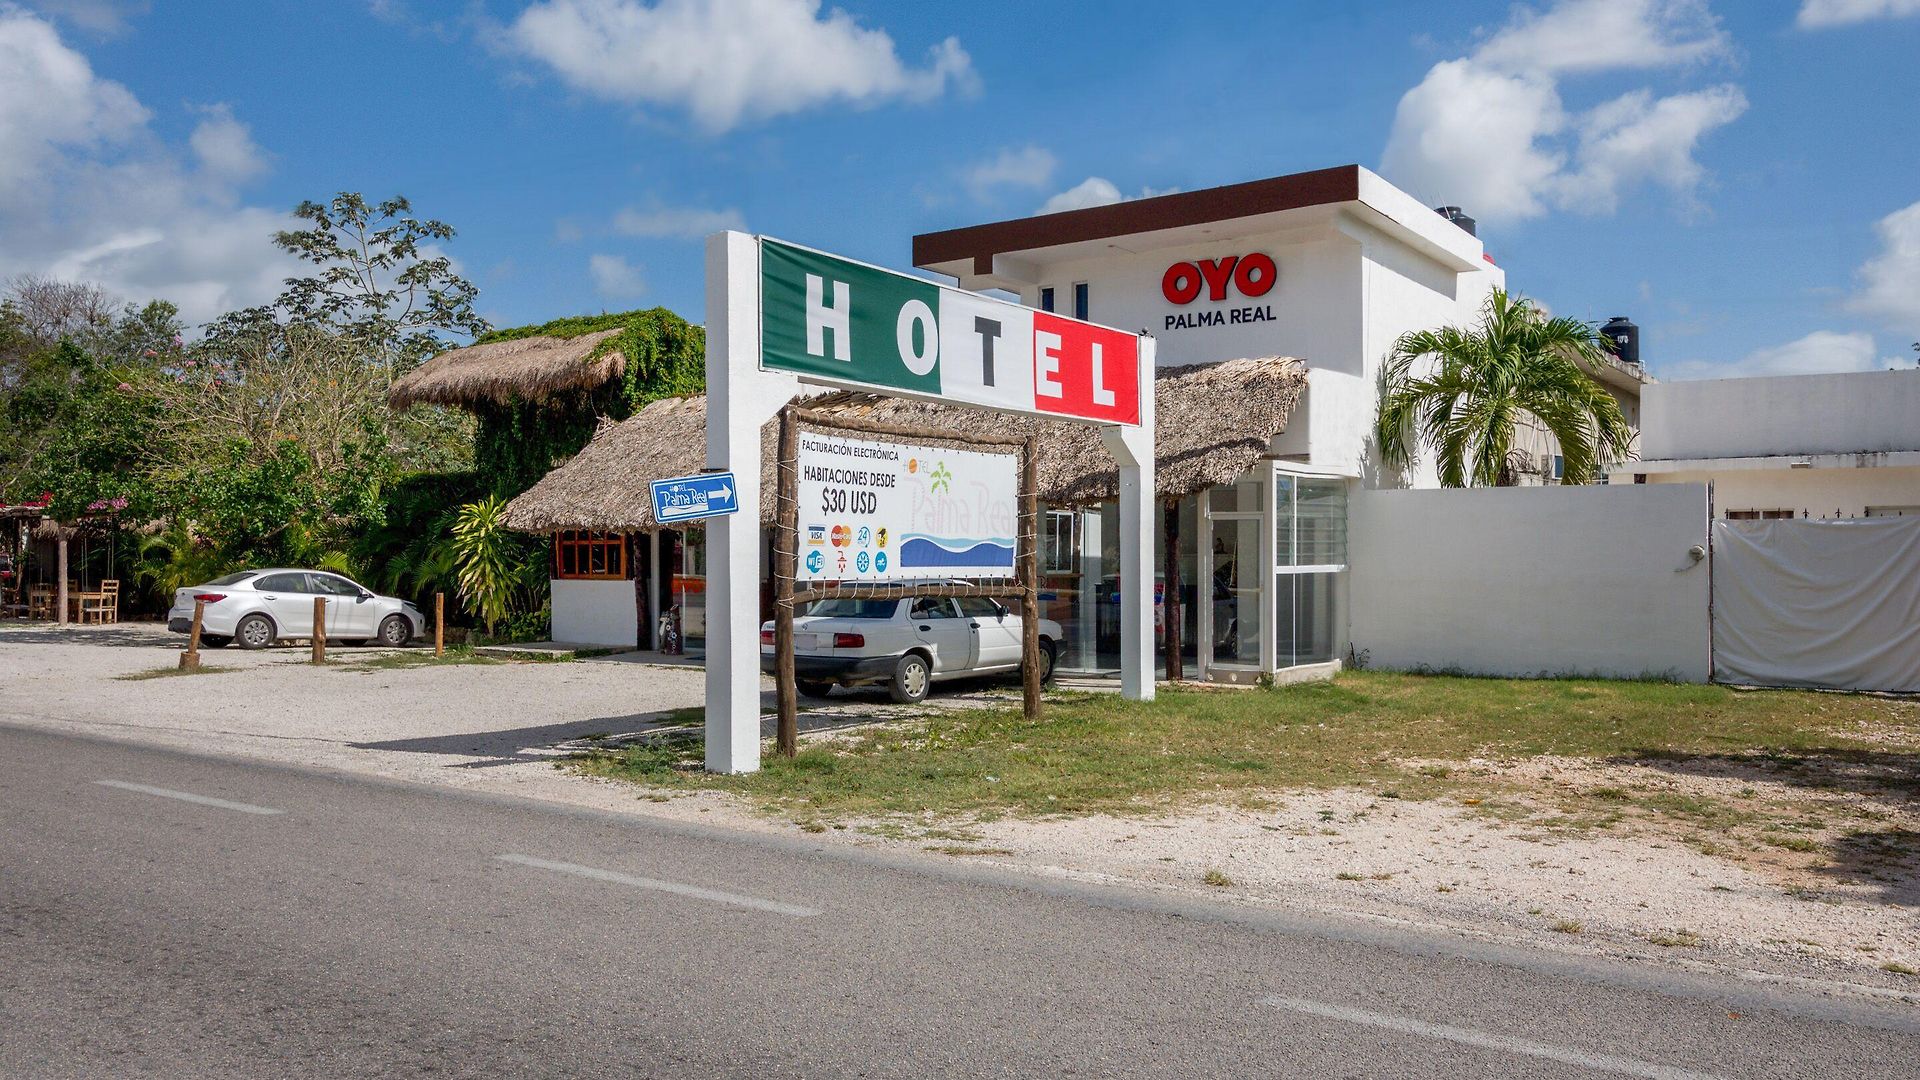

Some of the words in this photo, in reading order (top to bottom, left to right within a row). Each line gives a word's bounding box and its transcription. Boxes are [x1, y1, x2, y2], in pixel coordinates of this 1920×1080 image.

[1162, 253, 1277, 305] OYO
[1165, 311, 1225, 330] PALMA
[1230, 305, 1276, 324] REAL
[806, 273, 1116, 407] HOTEL
[802, 440, 852, 456] FACTURACIÓN
[854, 447, 899, 461] ELECTRÓNICA
[804, 465, 868, 486] HABITACIONES
[870, 473, 896, 488] DESDE
[660, 491, 691, 507] Palma
[687, 488, 708, 504] Real
[822, 486, 846, 516] $30
[851, 490, 877, 515] USD
[904, 477, 971, 535] Palma
[970, 480, 1015, 536] Real
[811, 532, 823, 540] VISA
[858, 529, 867, 541] 24
